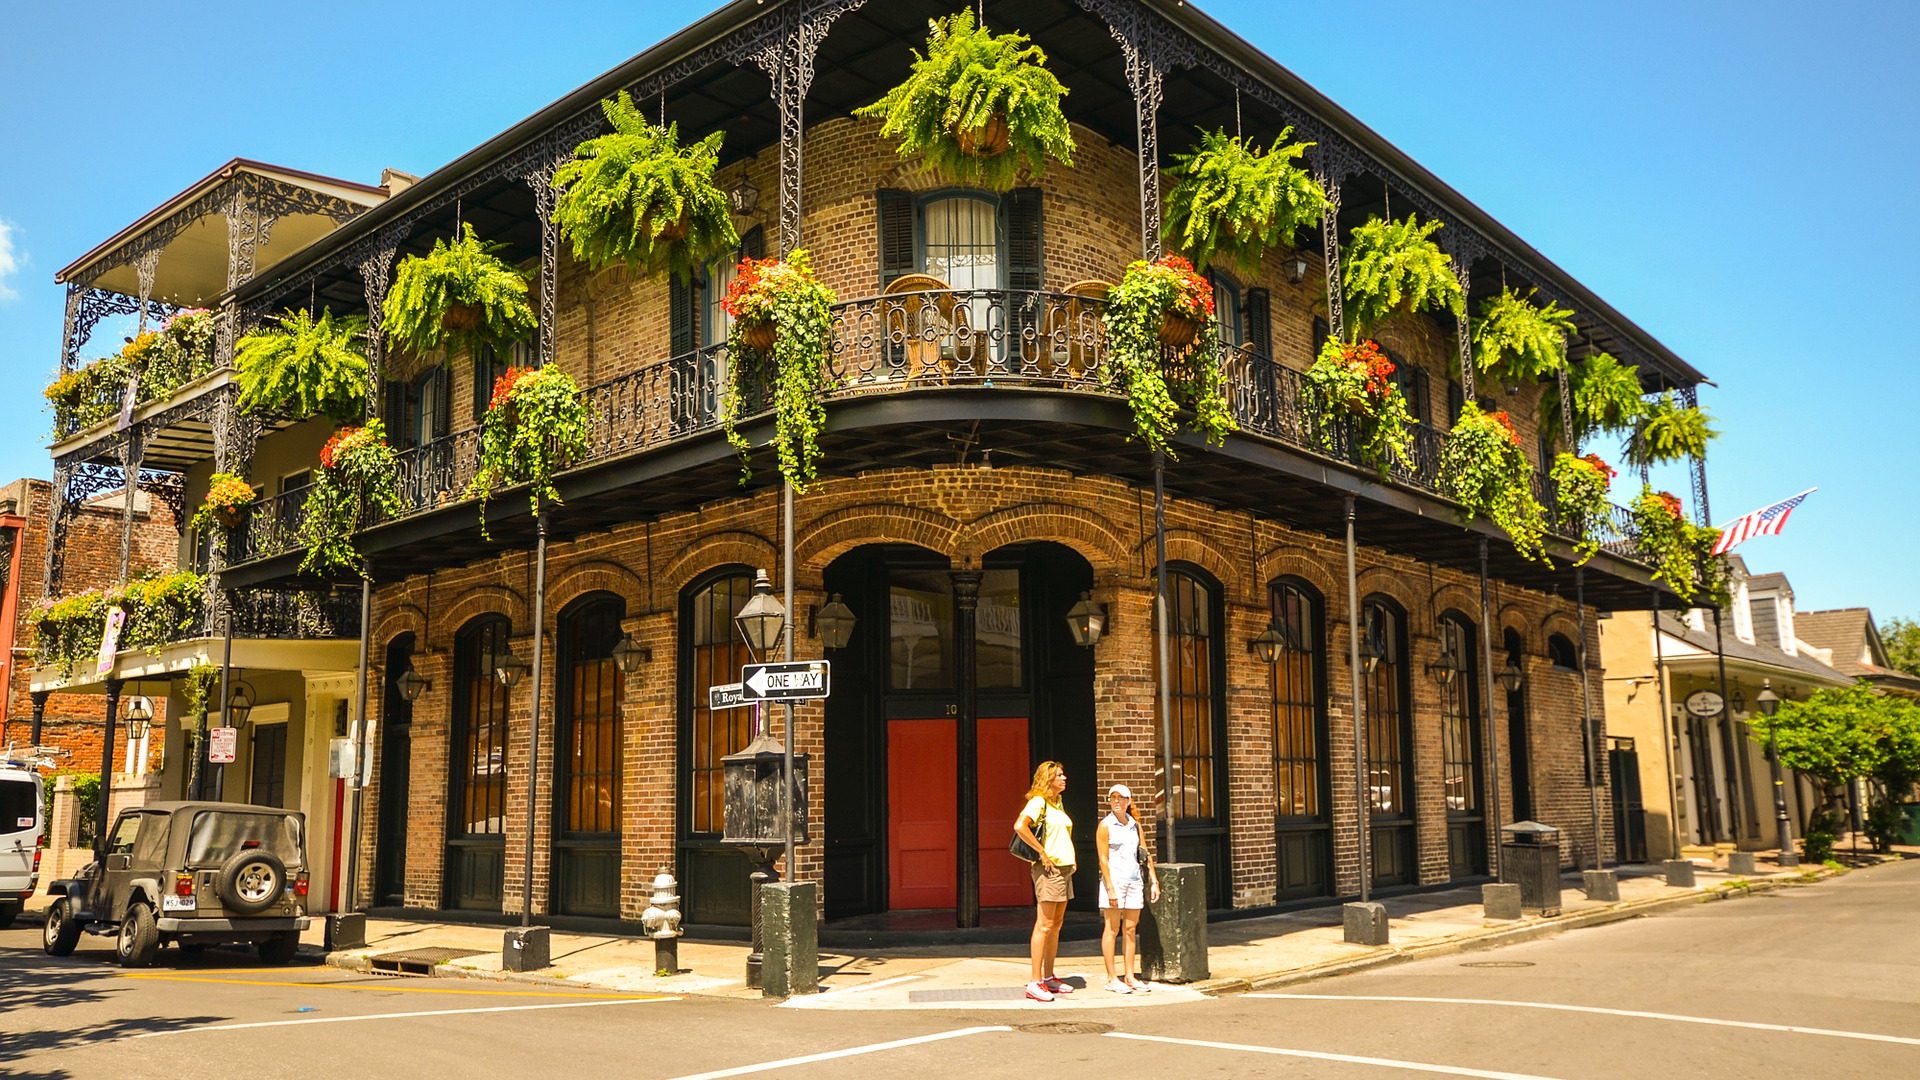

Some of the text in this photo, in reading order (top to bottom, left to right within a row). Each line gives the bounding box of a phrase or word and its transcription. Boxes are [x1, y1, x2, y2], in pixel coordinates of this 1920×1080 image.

[767, 675, 789, 688] ONE
[722, 692, 743, 705] Roya
[945, 704, 957, 715] 10
